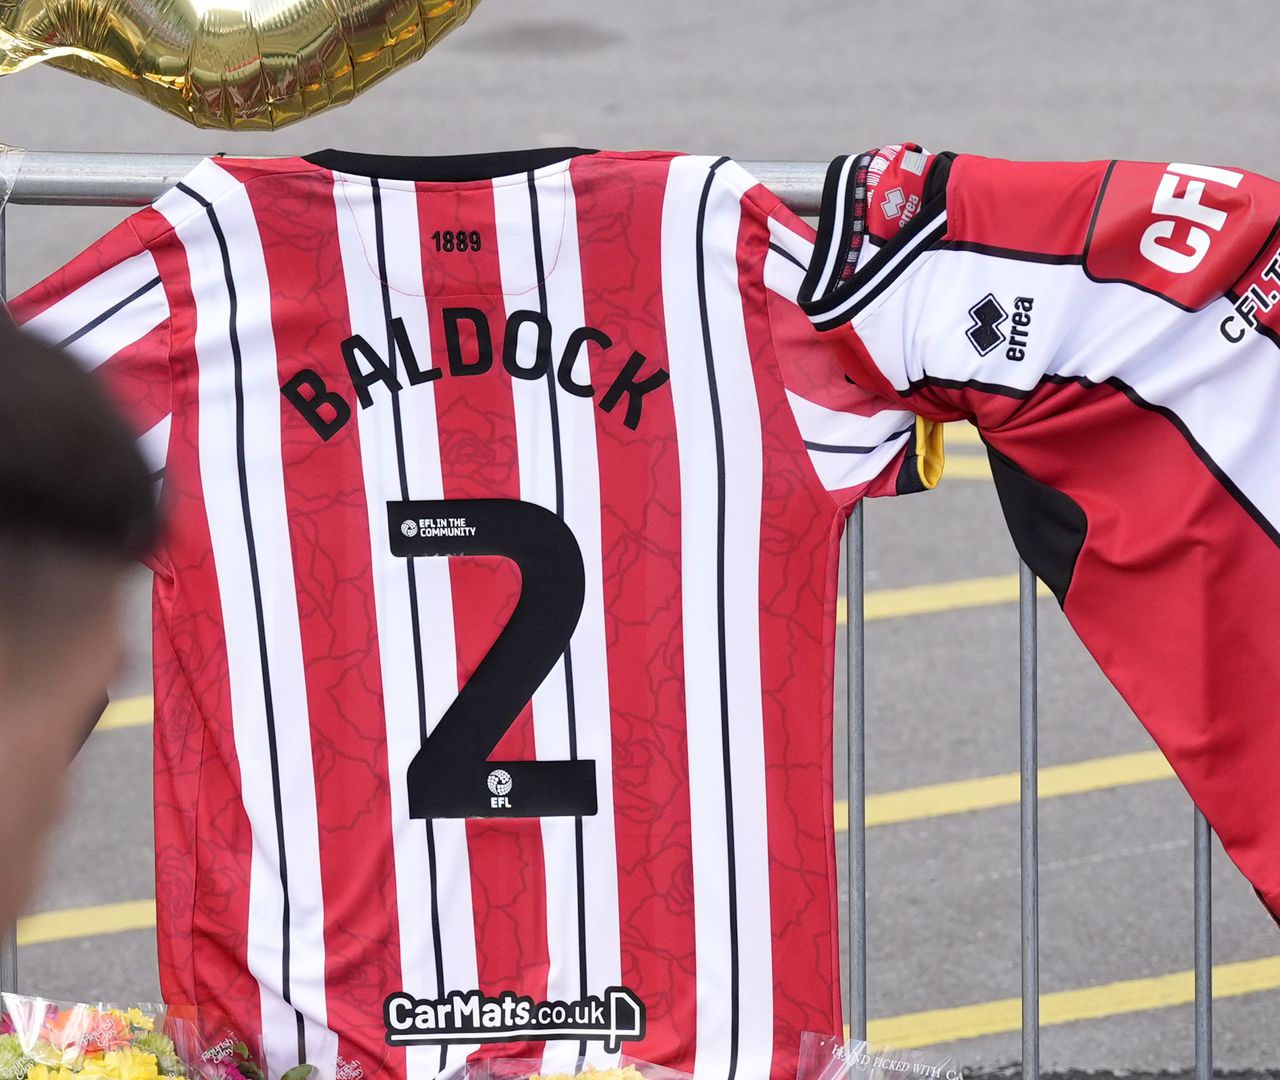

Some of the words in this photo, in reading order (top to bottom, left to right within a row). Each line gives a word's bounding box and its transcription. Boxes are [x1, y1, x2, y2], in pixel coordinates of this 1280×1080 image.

[1140, 163, 1245, 274] CFI
[431, 230, 482, 253] 1889
[280, 307, 670, 443] BALDOCK
[418, 518, 436, 528] EFL
[437, 518, 448, 528] IN
[448, 518, 467, 528] THE
[419, 526, 477, 537] COMMUNITY
[386, 498, 598, 819] 2
[490, 796, 512, 809] EFL
[388, 996, 606, 1030] CarMats.co.uk
[872, 1056, 910, 1073] PICKED
[912, 1062, 941, 1079] WITH
